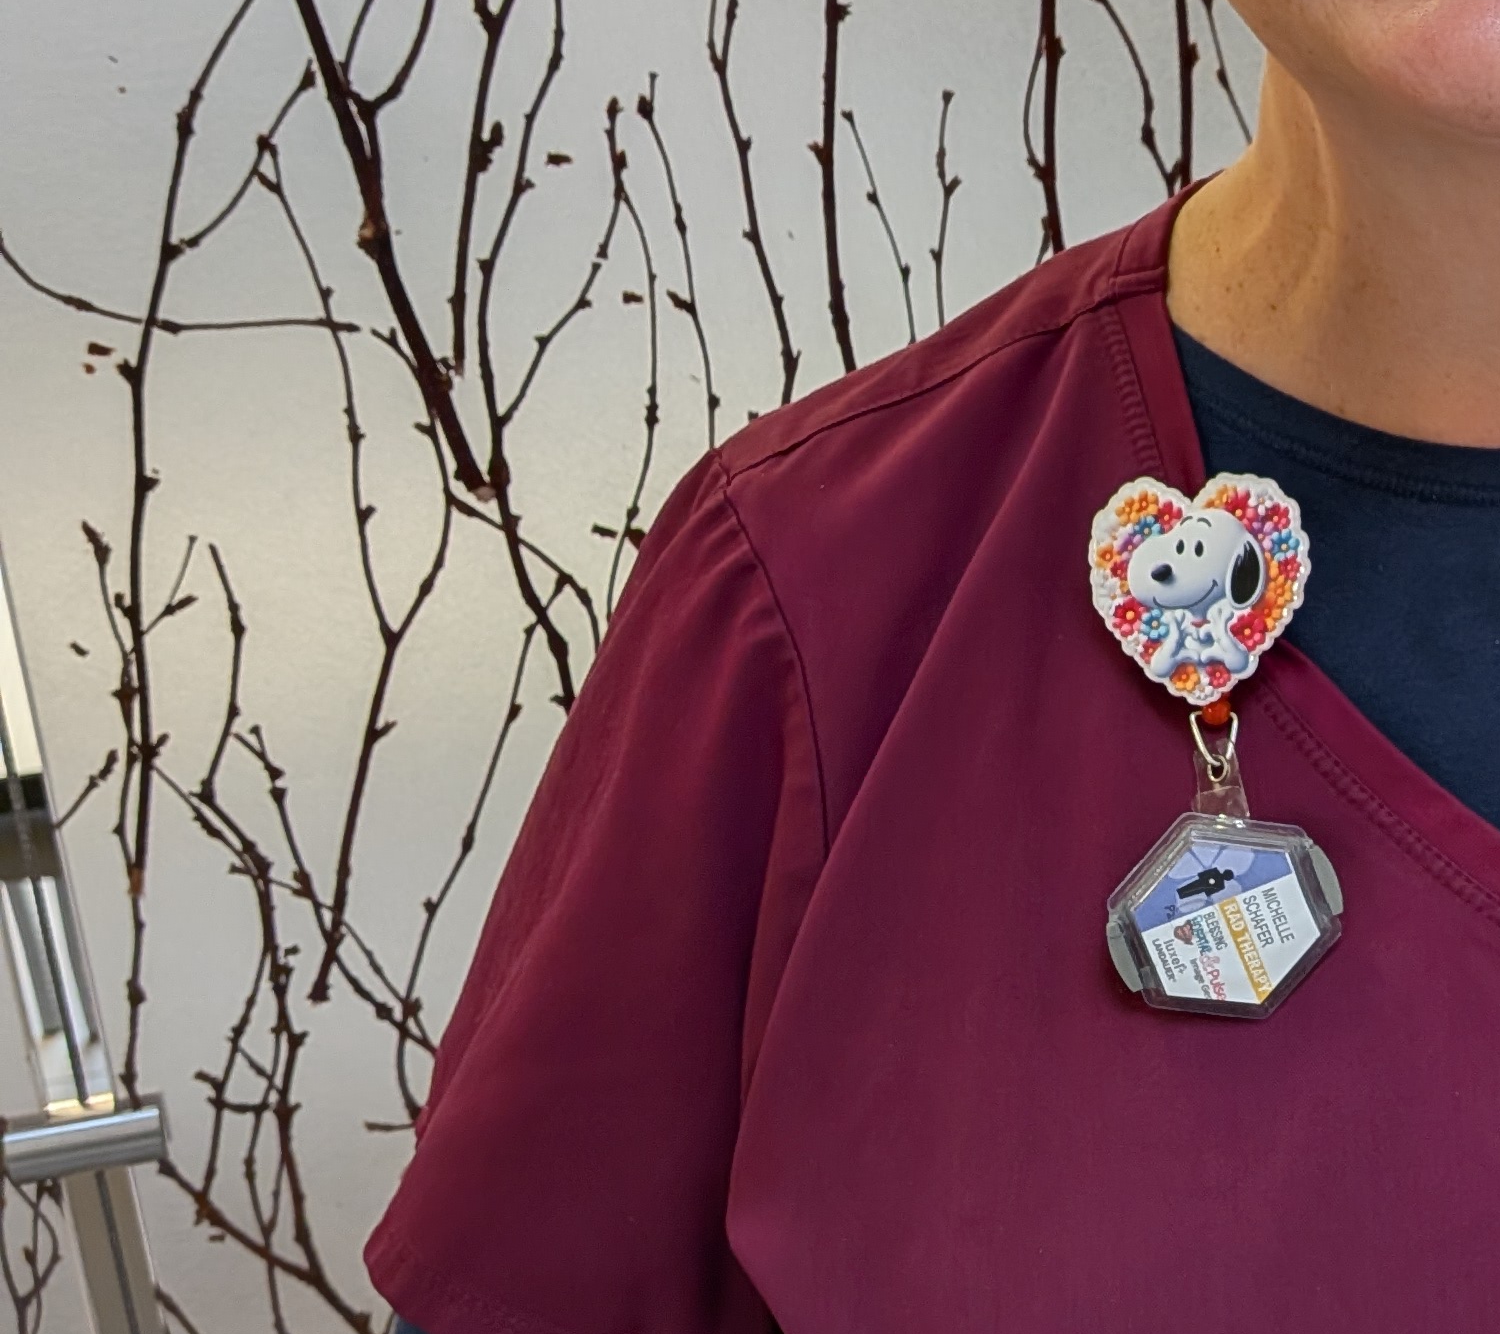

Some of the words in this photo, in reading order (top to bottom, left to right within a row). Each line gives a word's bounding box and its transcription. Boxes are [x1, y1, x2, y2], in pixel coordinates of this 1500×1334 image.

[1203, 911, 1228, 951] BLESSING
[1242, 894, 1275, 948] SCHAFER
[1262, 886, 1295, 944] MICHELLE
[1224, 903, 1243, 931] RAD
[1237, 934, 1272, 994] THERAPY
